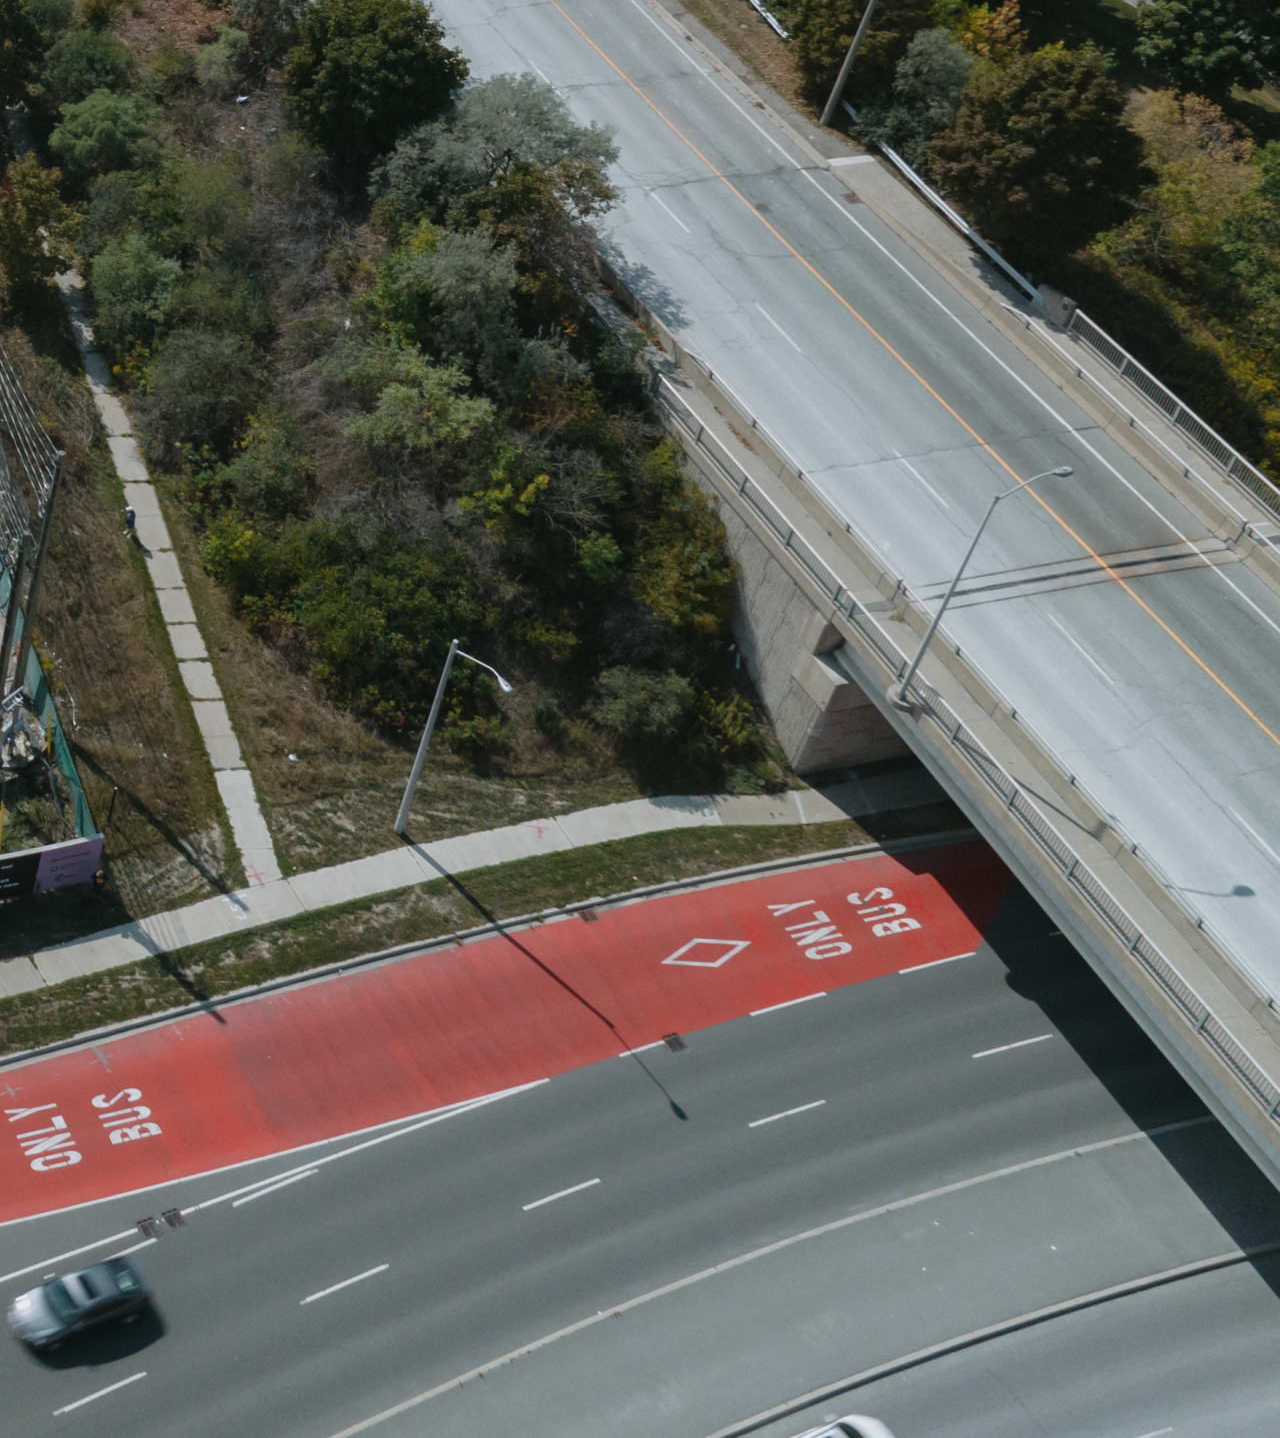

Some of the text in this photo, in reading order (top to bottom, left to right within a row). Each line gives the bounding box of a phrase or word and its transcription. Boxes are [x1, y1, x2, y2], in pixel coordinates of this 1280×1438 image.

[767, 899, 852, 960] ONLY
[847, 887, 922, 937] BUS
[4, 1103, 82, 1172] ONLY
[91, 1088, 162, 1144] BUS
